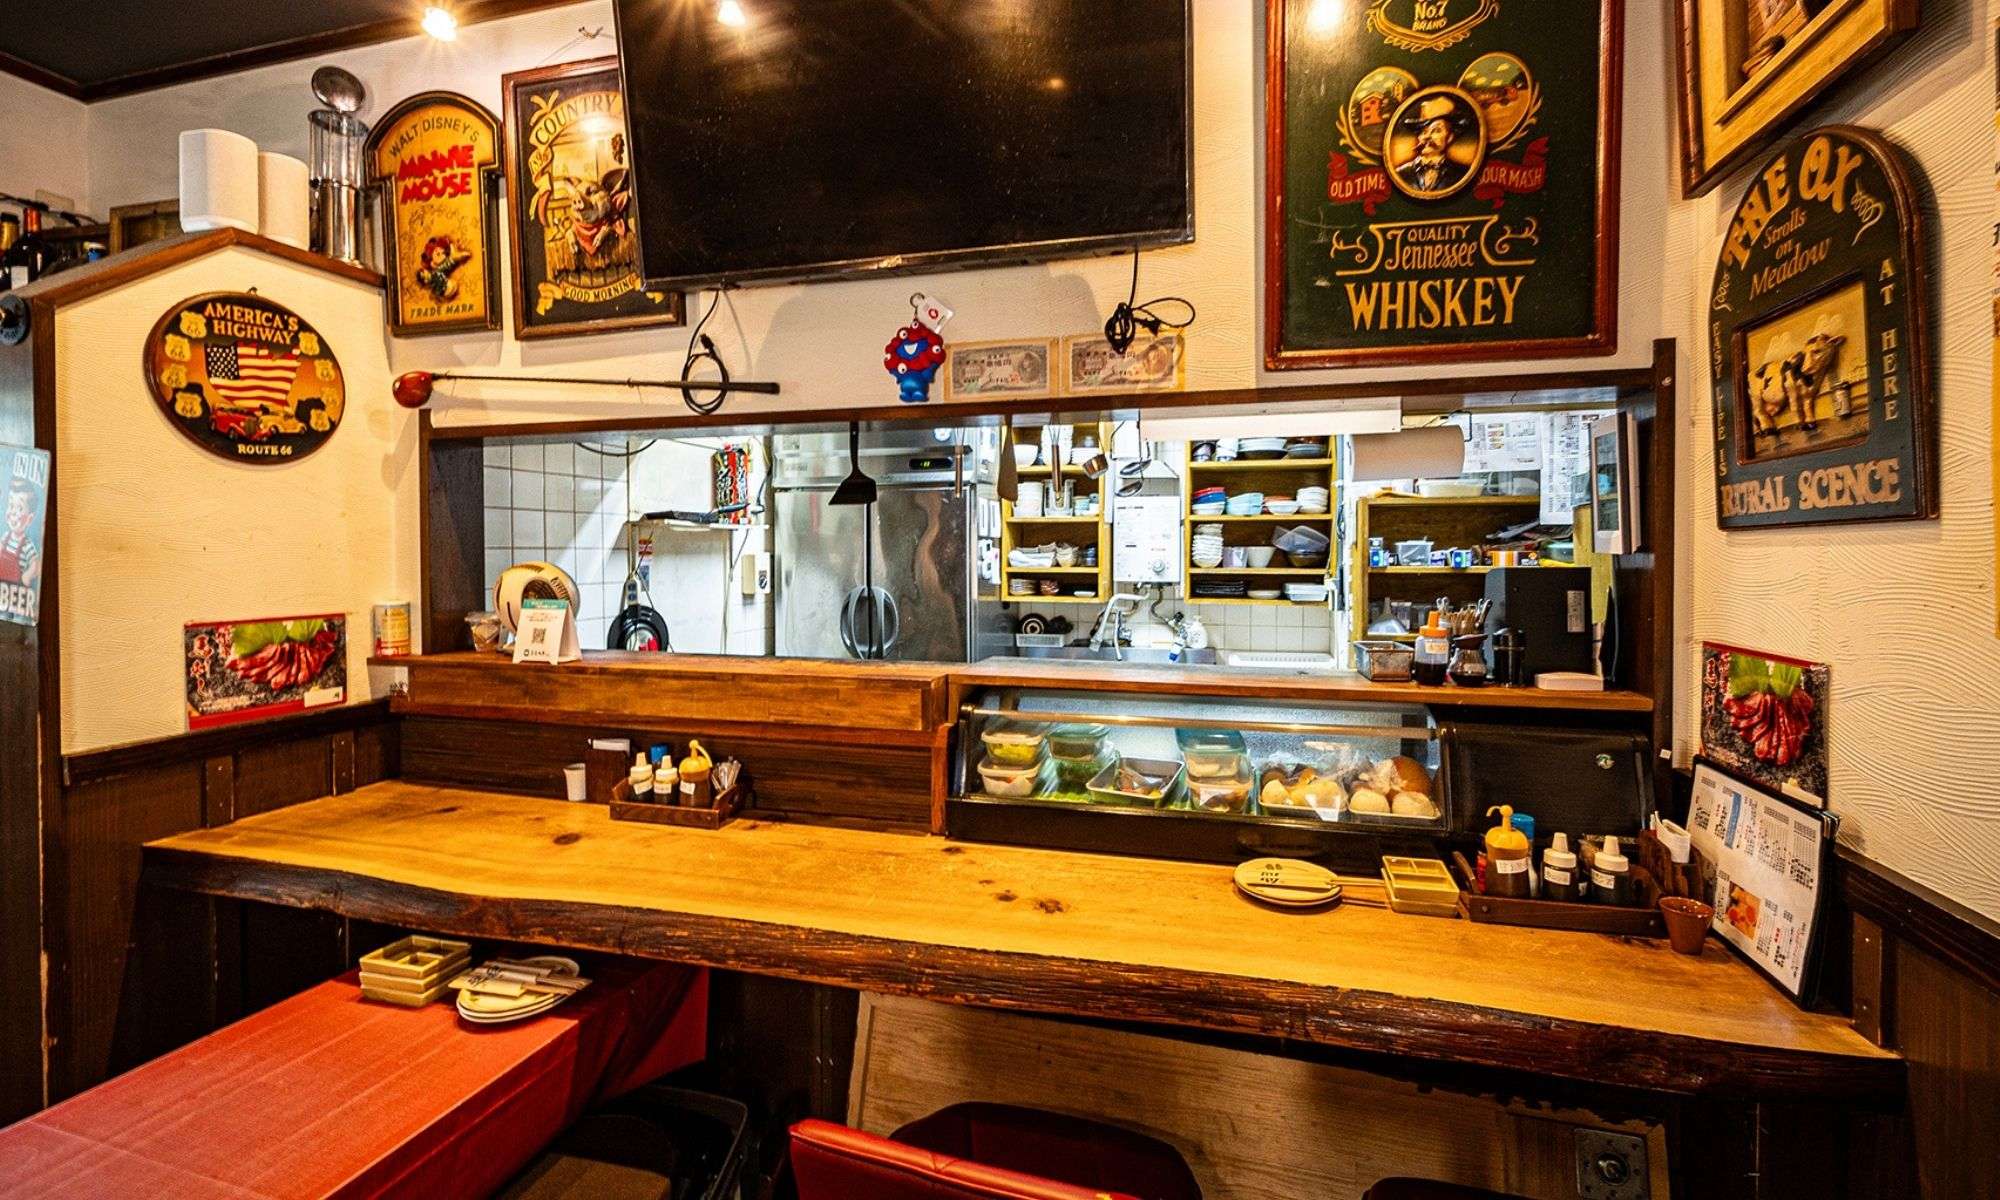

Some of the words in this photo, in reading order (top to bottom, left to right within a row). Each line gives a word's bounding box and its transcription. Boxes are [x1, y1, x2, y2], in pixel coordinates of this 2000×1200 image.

[1412, 17, 1448, 31] BRAND
[389, 124, 419, 158] WALT
[422, 116, 480, 143] DISNEY'S
[535, 95, 617, 146] COUNTRY
[400, 172, 472, 205] MOUSE
[1330, 181, 1353, 198] OLD
[1355, 175, 1386, 194] TIME
[1508, 168, 1543, 188] MASH
[1721, 153, 1791, 271] THE
[1763, 207, 1808, 250] Strolls
[1384, 227, 1478, 270] Tennessee
[1407, 224, 1472, 243] QUALITY
[1775, 238, 1793, 260] on
[1749, 237, 1832, 301] Meadow
[1879, 257, 1896, 306] AT
[411, 306, 442, 319] TRADE
[446, 303, 474, 314] MARK
[563, 286, 590, 301] GOOD
[1344, 275, 1526, 331] WHISKEY
[204, 302, 299, 331] AMERICA'S
[213, 319, 295, 344] HIGHWAY
[1881, 327, 1899, 421] HERE
[1712, 320, 1723, 379] EASY
[1719, 448, 1728, 477] IS
[237, 443, 279, 455] ROUTE
[280, 445, 293, 455] 66
[1721, 475, 1790, 518] RURAL
[0, 580, 36, 618] BEER
